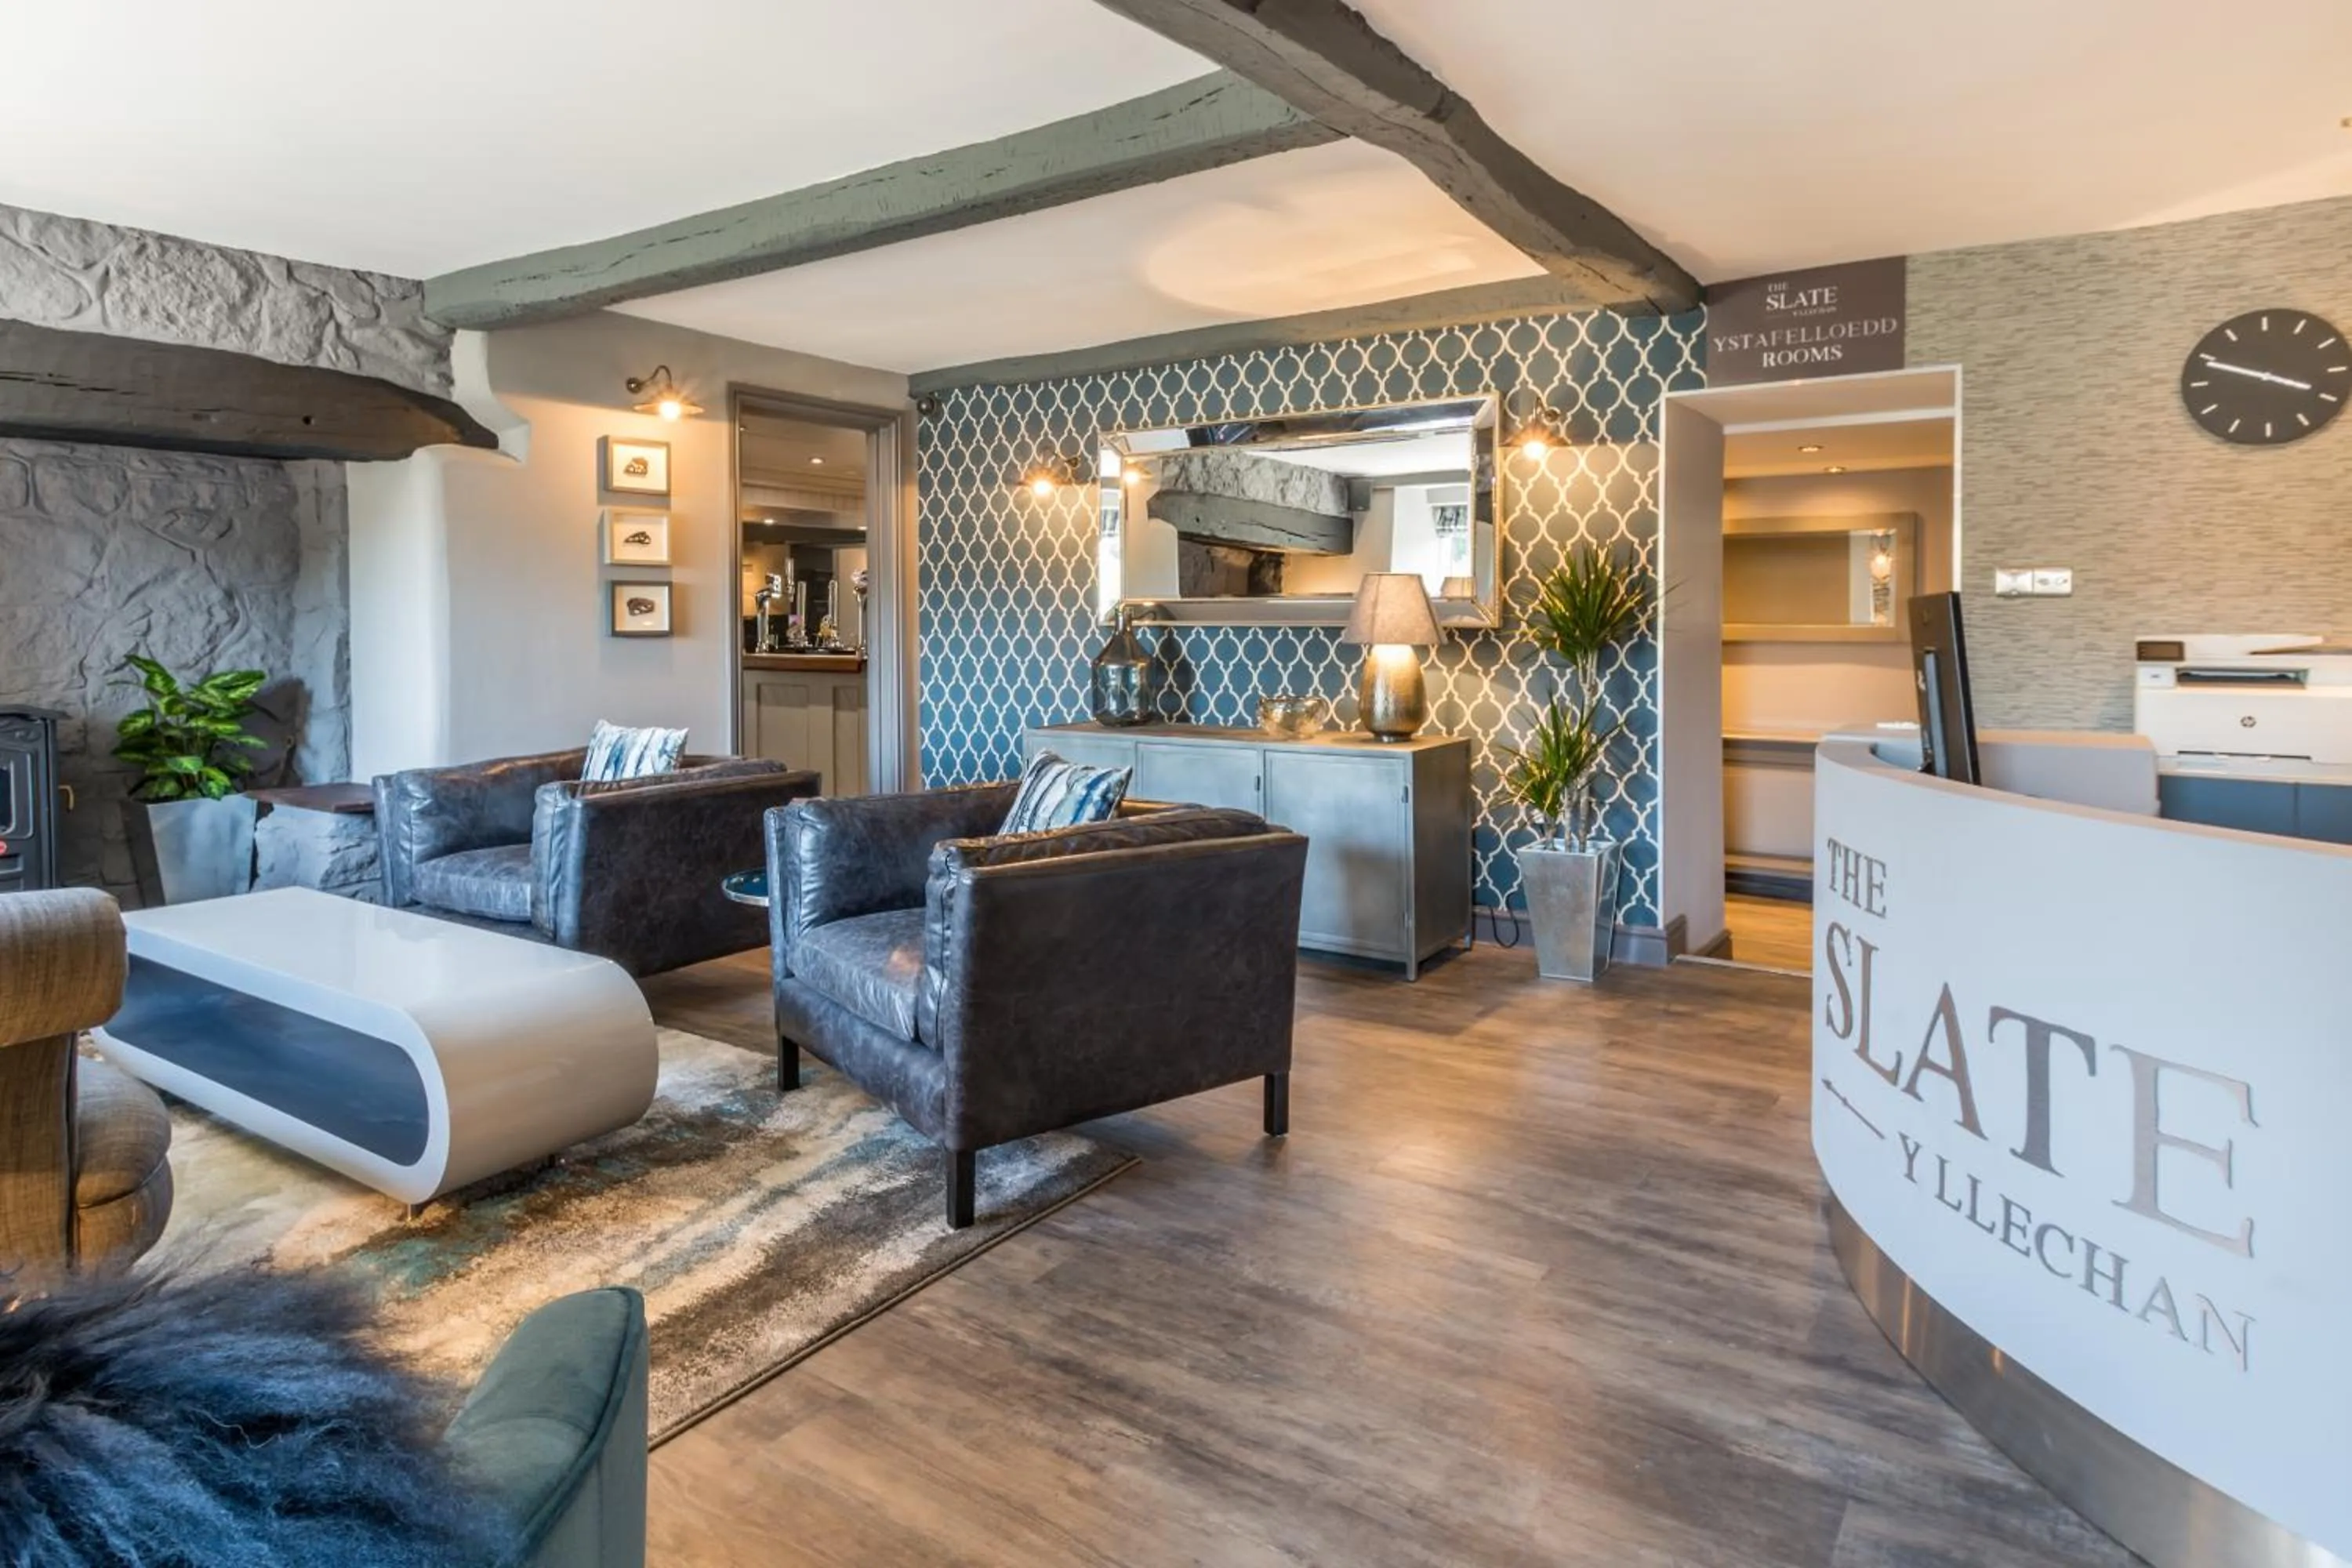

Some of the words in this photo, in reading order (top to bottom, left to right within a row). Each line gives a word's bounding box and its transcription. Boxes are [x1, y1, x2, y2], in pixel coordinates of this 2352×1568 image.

[1766, 285, 1838, 311] SLATE
[1713, 317, 1898, 352] YSTAFELLOEDD
[1762, 344, 1843, 368] ROOMS
[1827, 837, 1887, 919] THE
[1825, 921, 2260, 1259] SLATE
